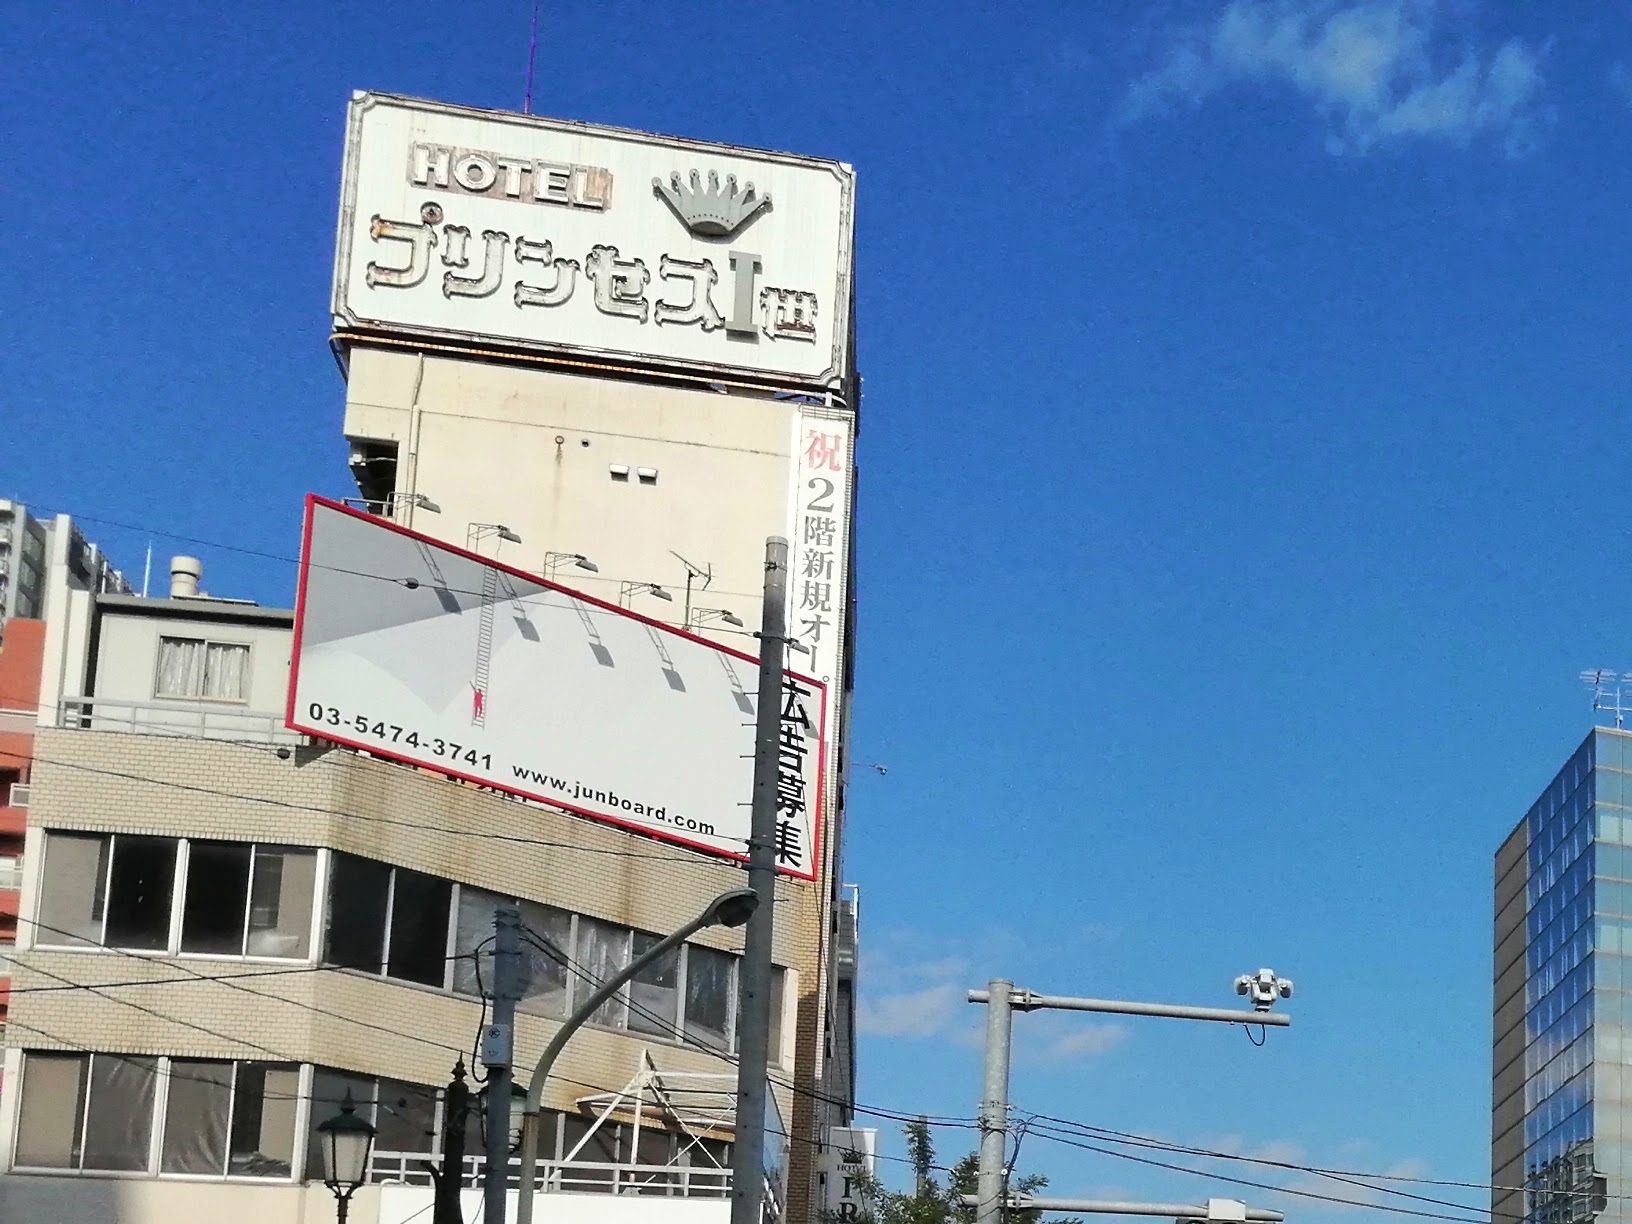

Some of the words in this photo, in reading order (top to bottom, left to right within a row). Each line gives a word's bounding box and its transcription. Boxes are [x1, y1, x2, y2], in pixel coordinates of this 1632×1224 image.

[412, 142, 611, 210] HOTEL
[308, 702, 494, 772] 03-5474-3741
[512, 764, 716, 836] www.junboard.com
